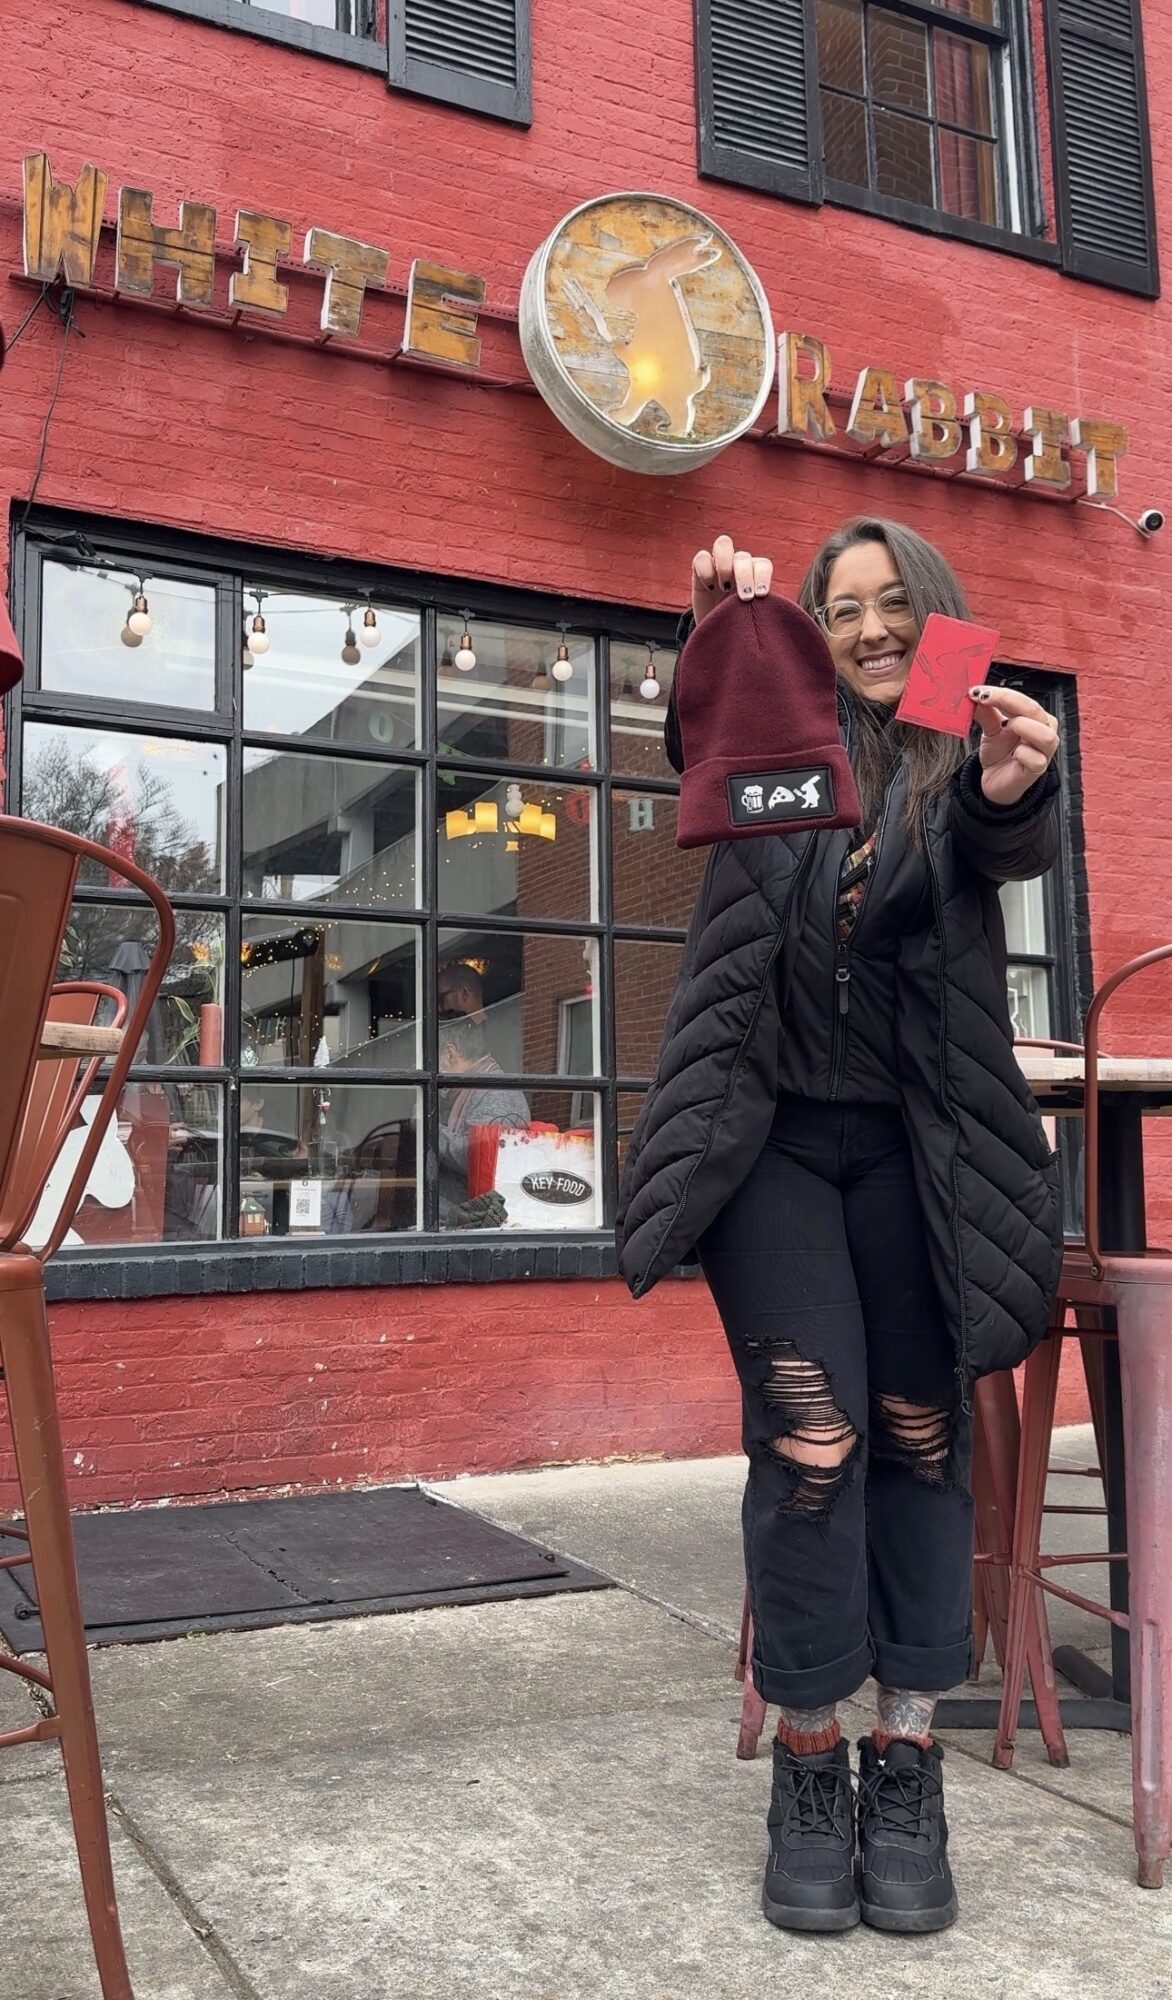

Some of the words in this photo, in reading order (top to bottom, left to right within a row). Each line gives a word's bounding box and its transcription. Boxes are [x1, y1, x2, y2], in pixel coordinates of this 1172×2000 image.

[22, 152, 486, 368] WHITE
[777, 331, 1128, 497] RABBIT
[530, 1176, 553, 1190] KEY
[556, 1177, 585, 1197] FOOD
